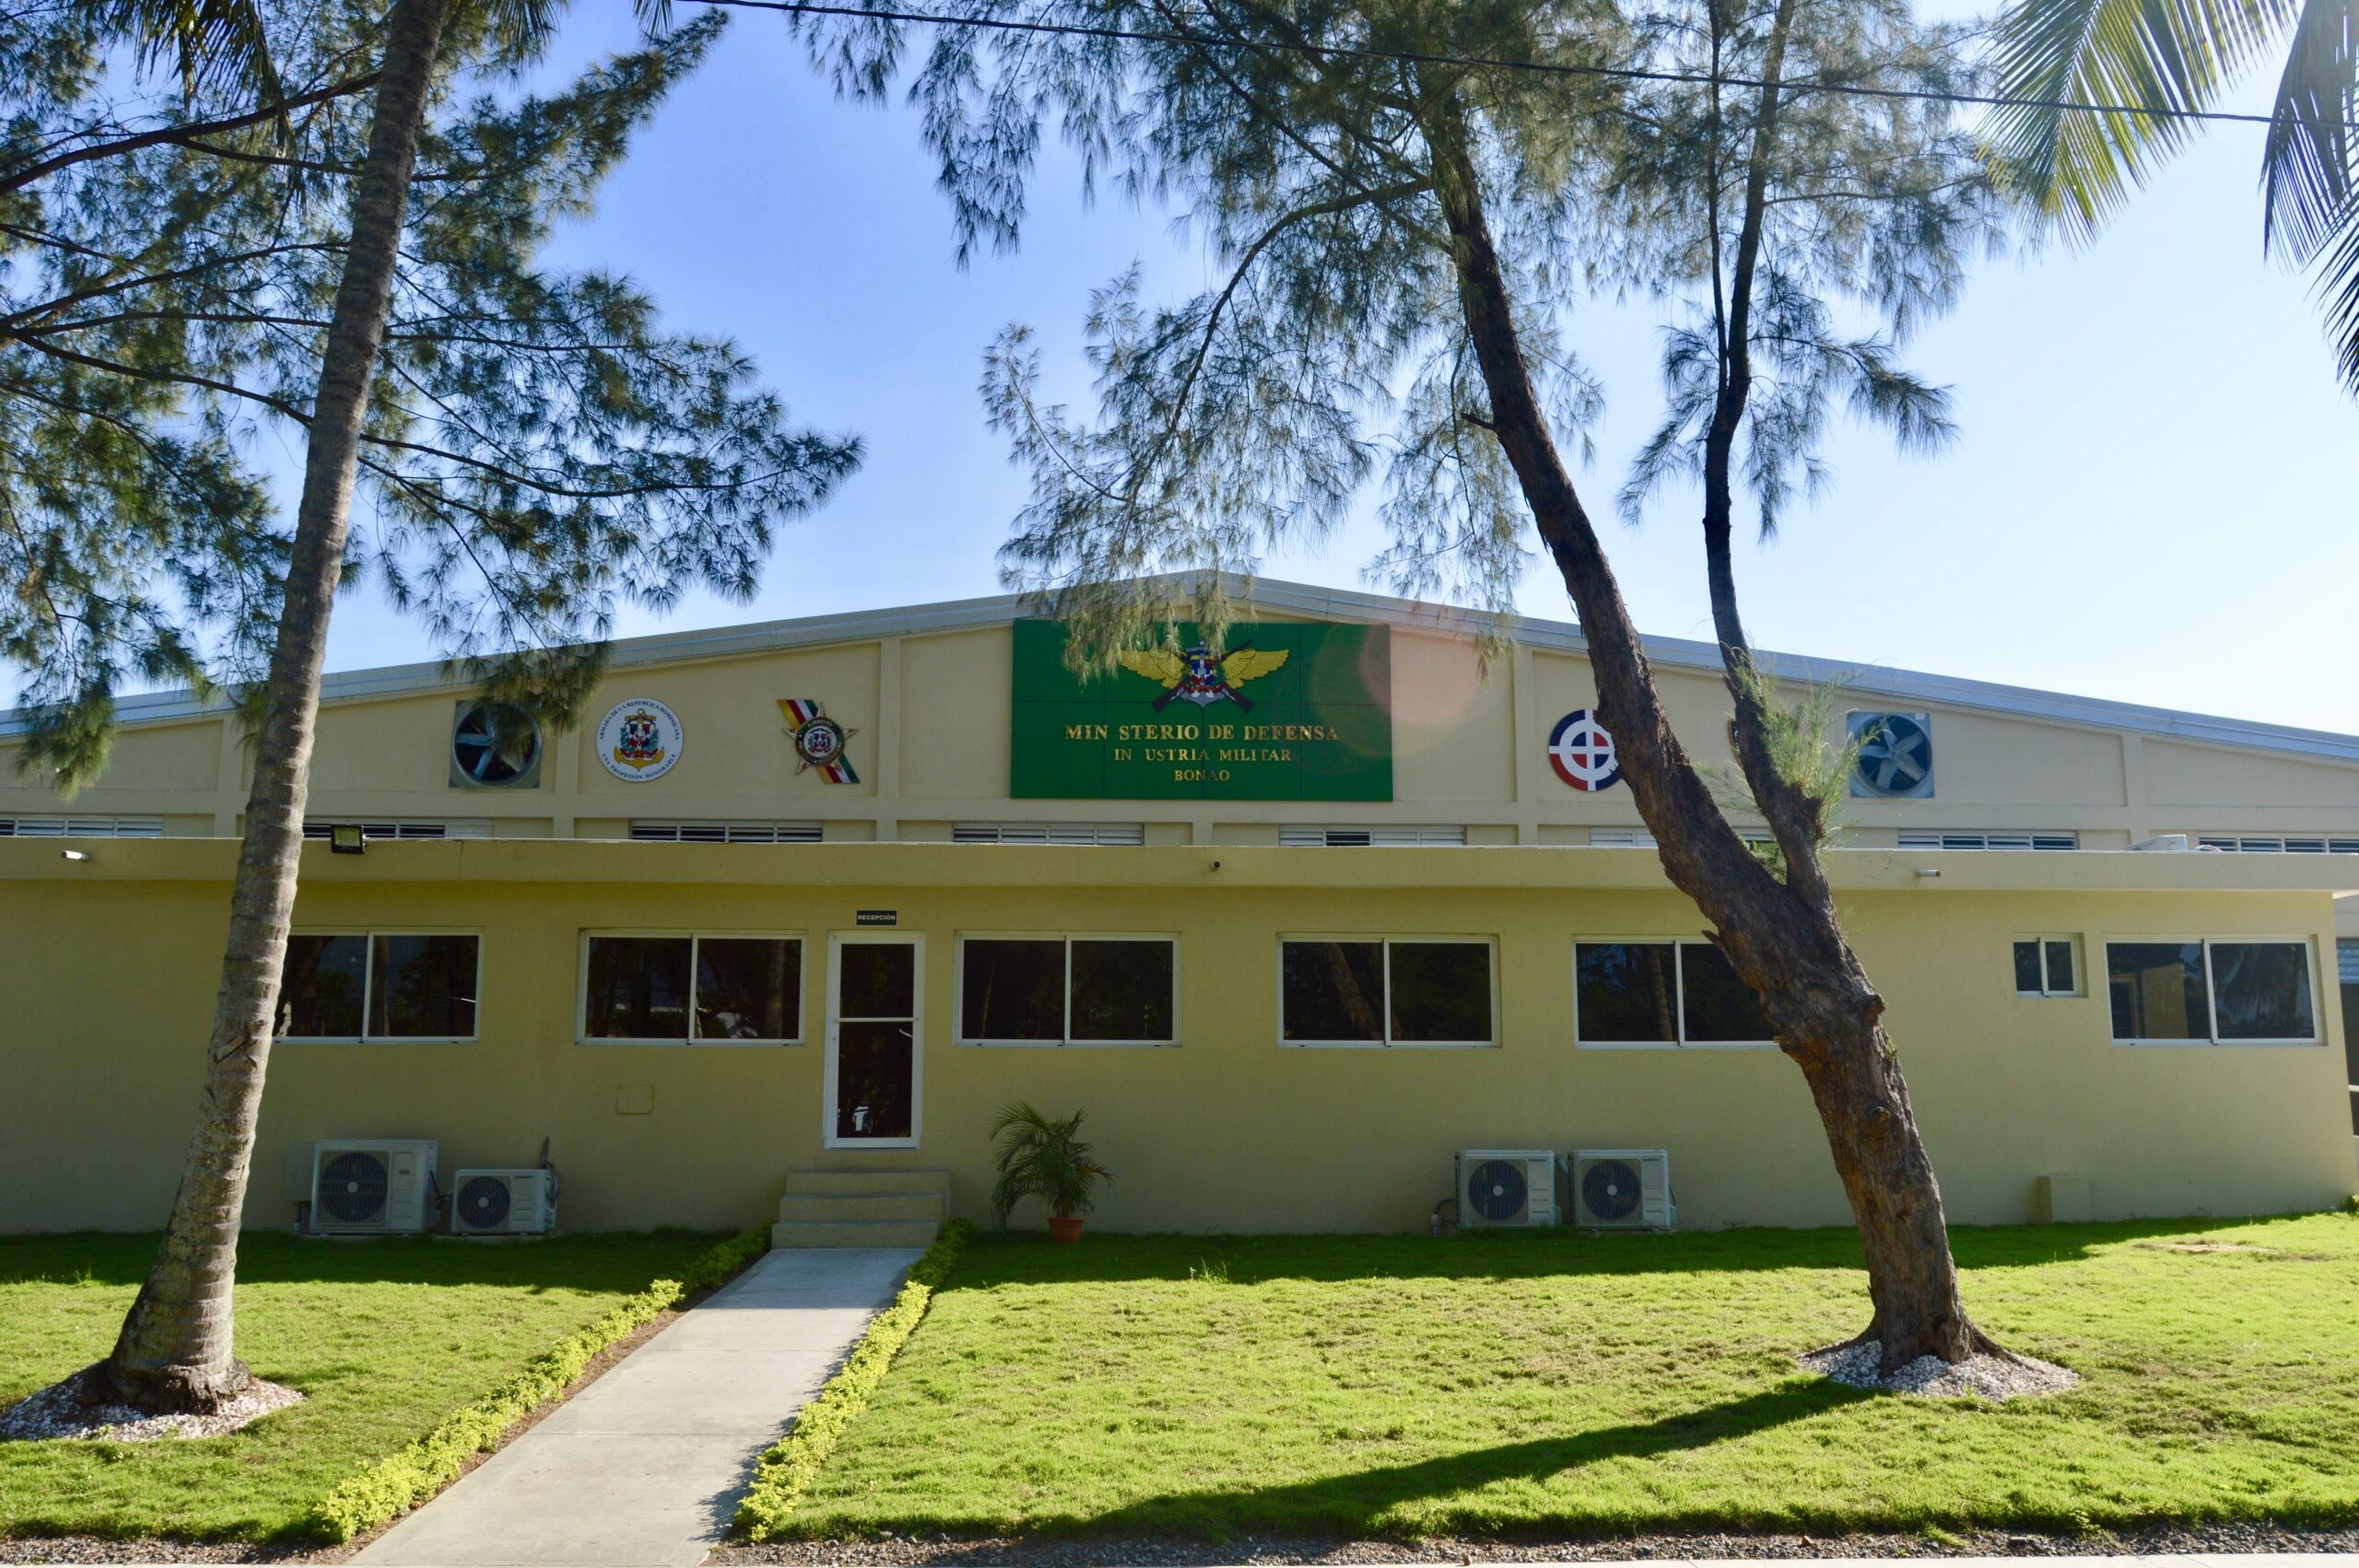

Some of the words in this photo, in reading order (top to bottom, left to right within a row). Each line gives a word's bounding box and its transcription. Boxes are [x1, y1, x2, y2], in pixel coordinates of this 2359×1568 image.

[599, 715, 613, 739] ARMADA
[611, 708, 618, 717] DE
[659, 707, 680, 740] DOMINICANA
[1208, 724, 1234, 740] DE
[1243, 725, 1341, 741] DEFENSA
[1219, 749, 1292, 761] MILITAR
[645, 754, 675, 778] HONORABLE
[1174, 769, 1230, 781] BONAO
